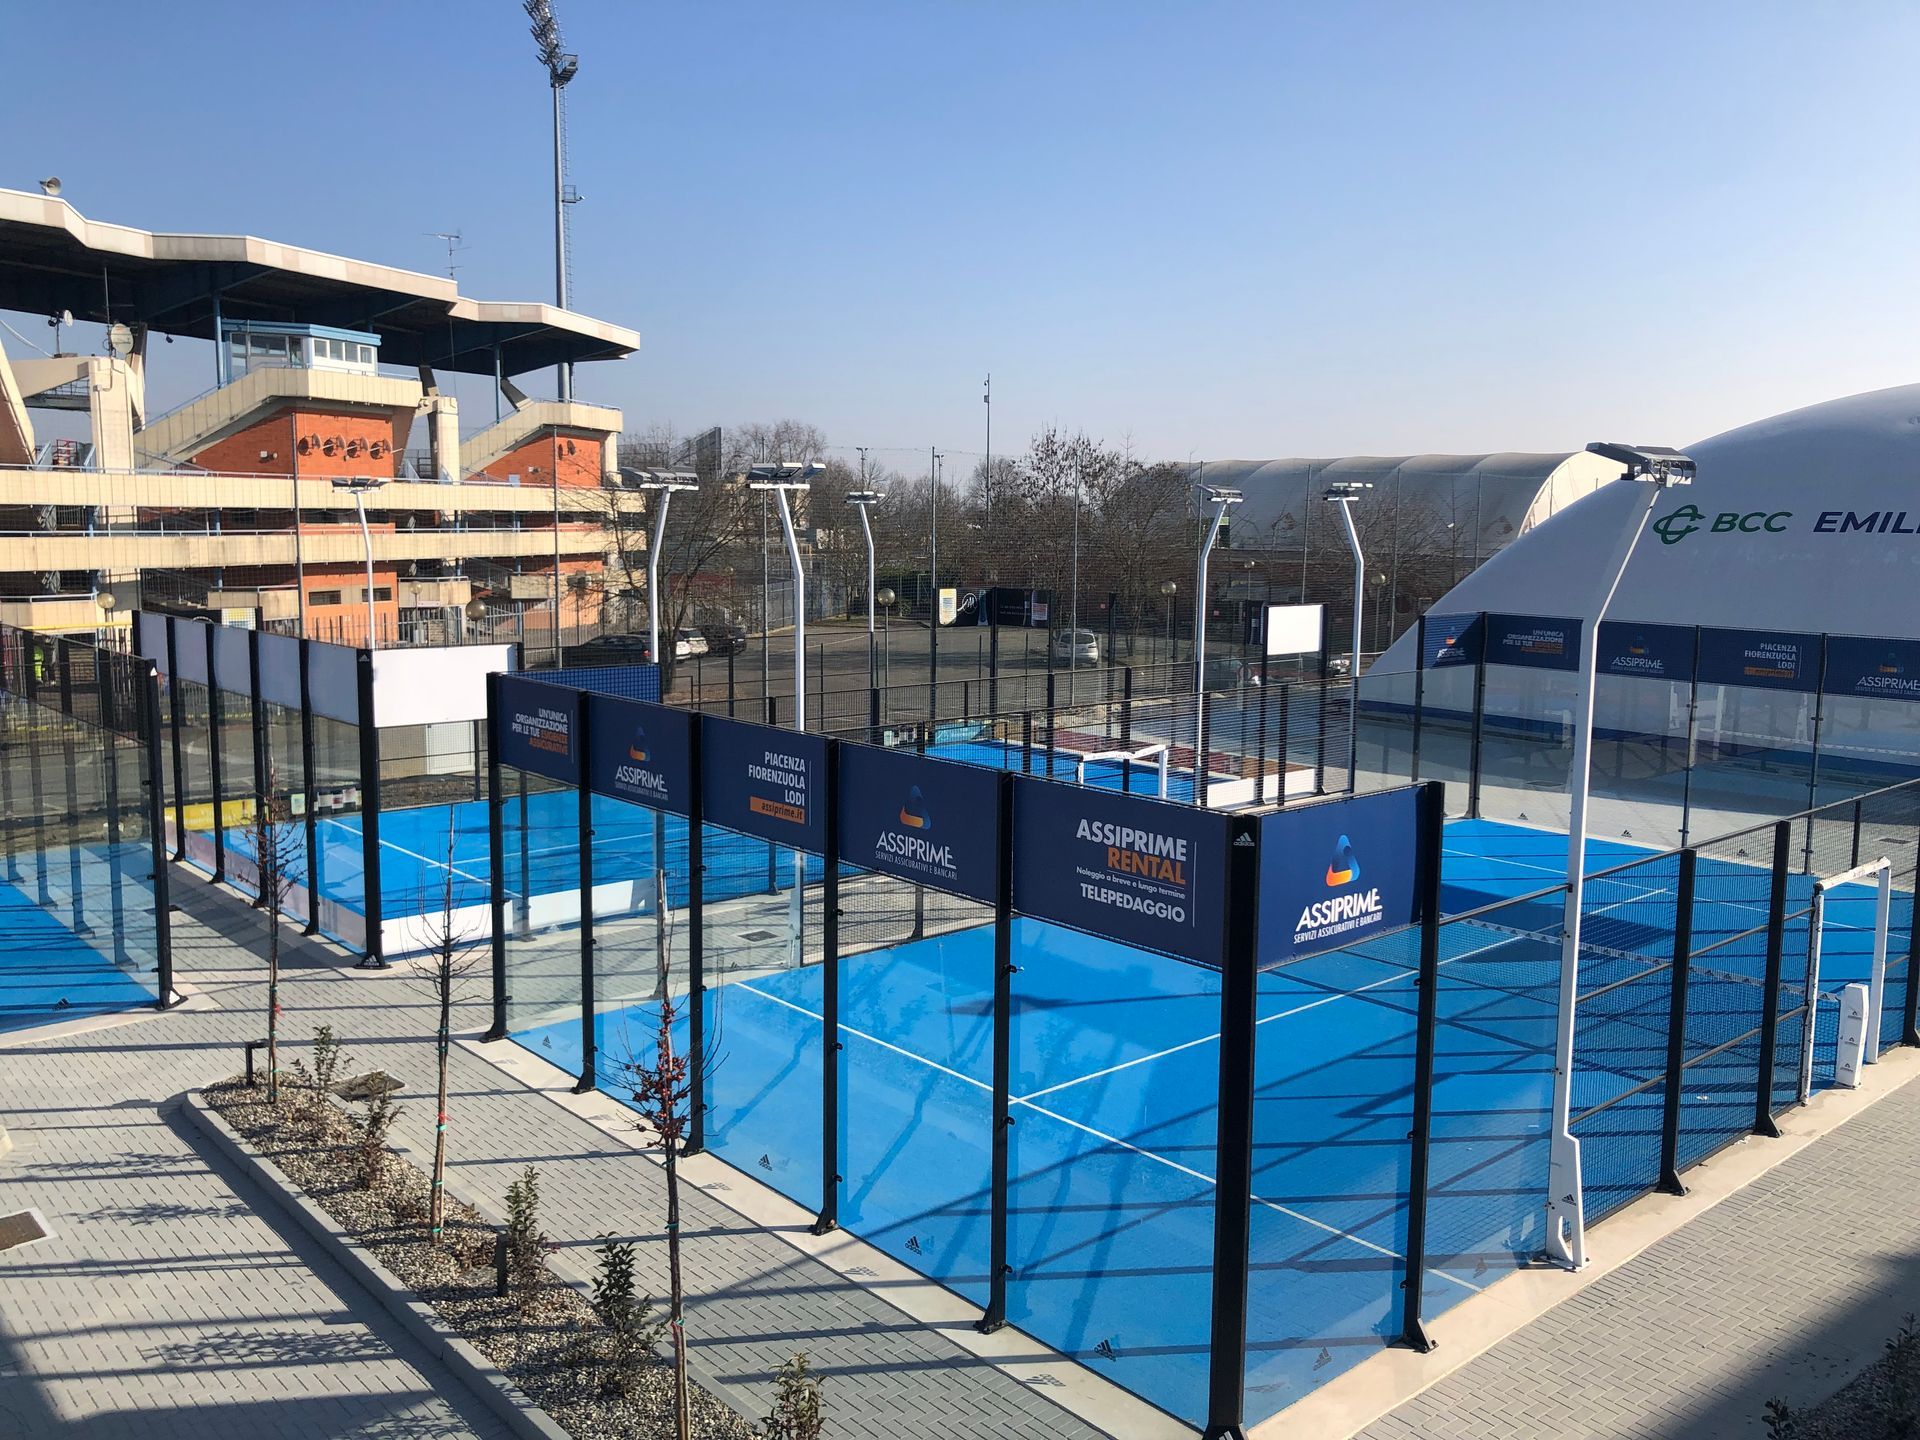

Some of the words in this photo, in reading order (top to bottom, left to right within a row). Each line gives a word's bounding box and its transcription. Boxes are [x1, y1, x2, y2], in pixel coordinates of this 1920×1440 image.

[1710, 511, 1793, 533] BCC
[1812, 511, 1920, 534] EMIL
[1744, 650, 1797, 661] FIORENZUOLA
[1760, 643, 1797, 652] PIACENZA
[1612, 656, 1664, 670] ASSIPRIME
[1778, 660, 1795, 669] LODI
[1856, 676, 1920, 690] ASSIPRIME
[512, 722, 522, 733] PER
[523, 724, 529, 735] LE
[530, 727, 540, 737] TUE
[515, 713, 568, 734] ORGANIZZAZIONE
[764, 751, 806, 773] PIACENZA
[615, 764, 668, 792] ASSIPRIME
[748, 764, 806, 789] FIORENZUOLA
[784, 789, 805, 806] LODI
[761, 802, 803, 820] assiprime.it
[876, 830, 957, 870] ASSIPRIME
[1076, 818, 1187, 862] ASSIPRIME
[875, 850, 894, 863] SERVIZI
[895, 854, 929, 872] ASSICURATIVI
[929, 865, 933, 873] E
[933, 866, 958, 880] BANCARI
[1107, 847, 1186, 885] RENTAL
[1076, 866, 1106, 880] Noleggio
[1112, 874, 1131, 887] breve
[1138, 881, 1157, 893] lungo
[1158, 887, 1186, 899] termine
[1080, 882, 1186, 923] TELEPEDAGGIO
[1295, 888, 1383, 932] ASSIPRIME
[1293, 928, 1317, 944] SERVIZI
[1317, 919, 1355, 938] ASSICURATIVI
[1355, 918, 1360, 928] E
[1360, 912, 1383, 926] BANCARI
